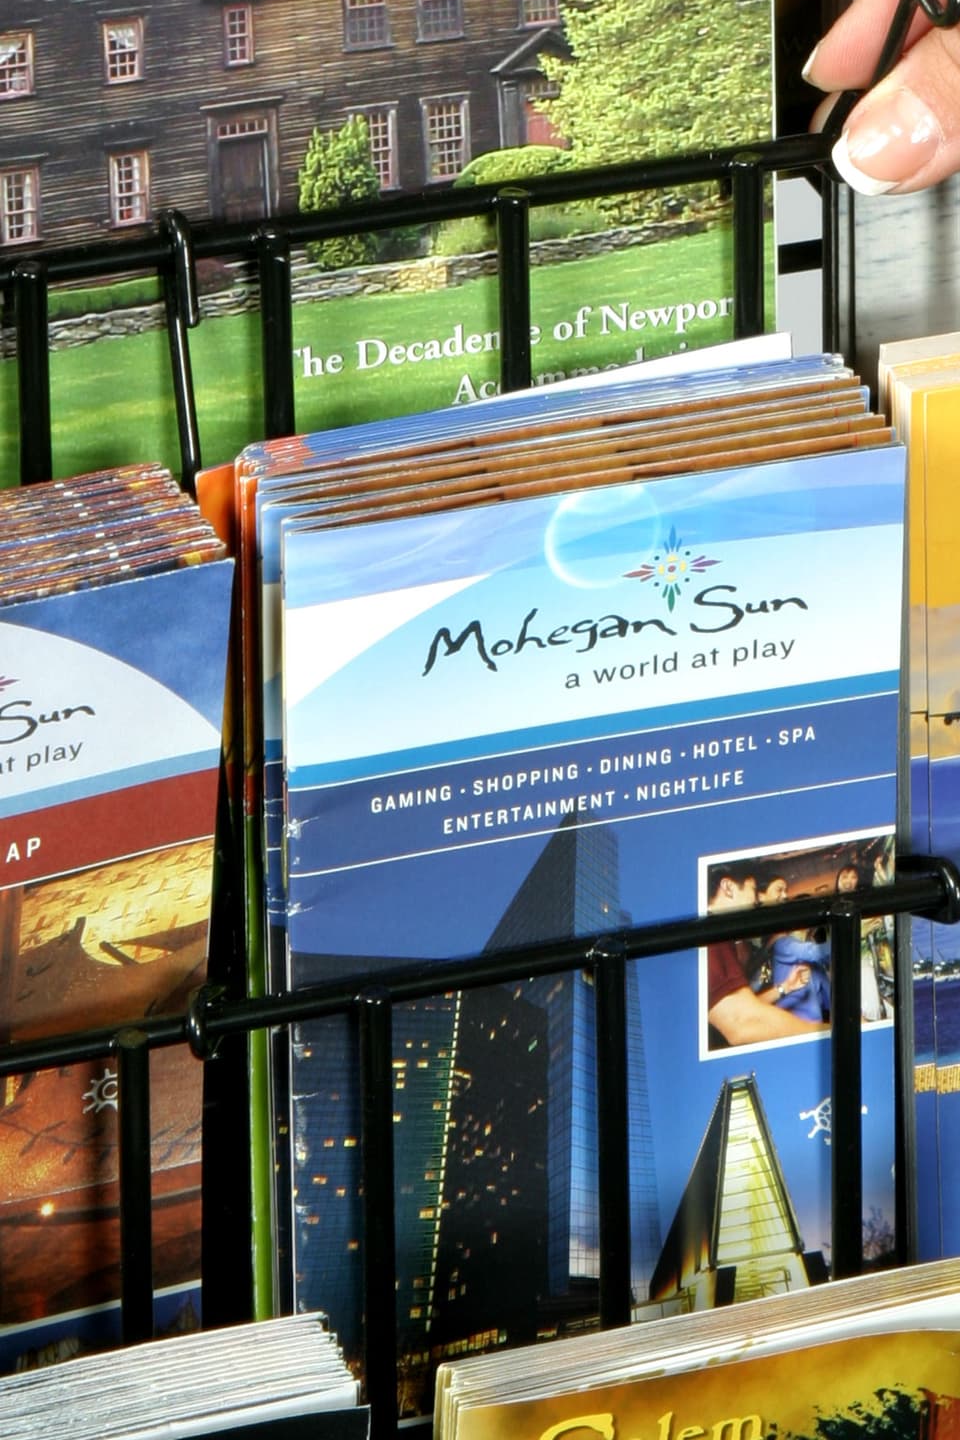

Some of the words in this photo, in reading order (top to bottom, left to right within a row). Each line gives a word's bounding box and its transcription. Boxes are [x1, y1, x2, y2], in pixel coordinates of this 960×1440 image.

[293, 345, 344, 378] he
[356, 322, 541, 371] Decadene
[552, 306, 592, 342] of
[600, 295, 735, 335] Newpor
[421, 608, 678, 678] Mohegan
[689, 584, 809, 634] Sun
[564, 671, 582, 691] a
[593, 652, 679, 686] world
[690, 646, 720, 669] at
[732, 639, 798, 668] play
[26, 741, 84, 772] play
[371, 786, 453, 815] GAMING
[472, 764, 580, 797] SHOPPING
[600, 748, 673, 776] DINING
[692, 734, 758, 759] HOTEL
[778, 726, 817, 746] SPA
[443, 792, 617, 836] ENTERTAINMENT
[636, 769, 746, 802] NIGHTLIFE
